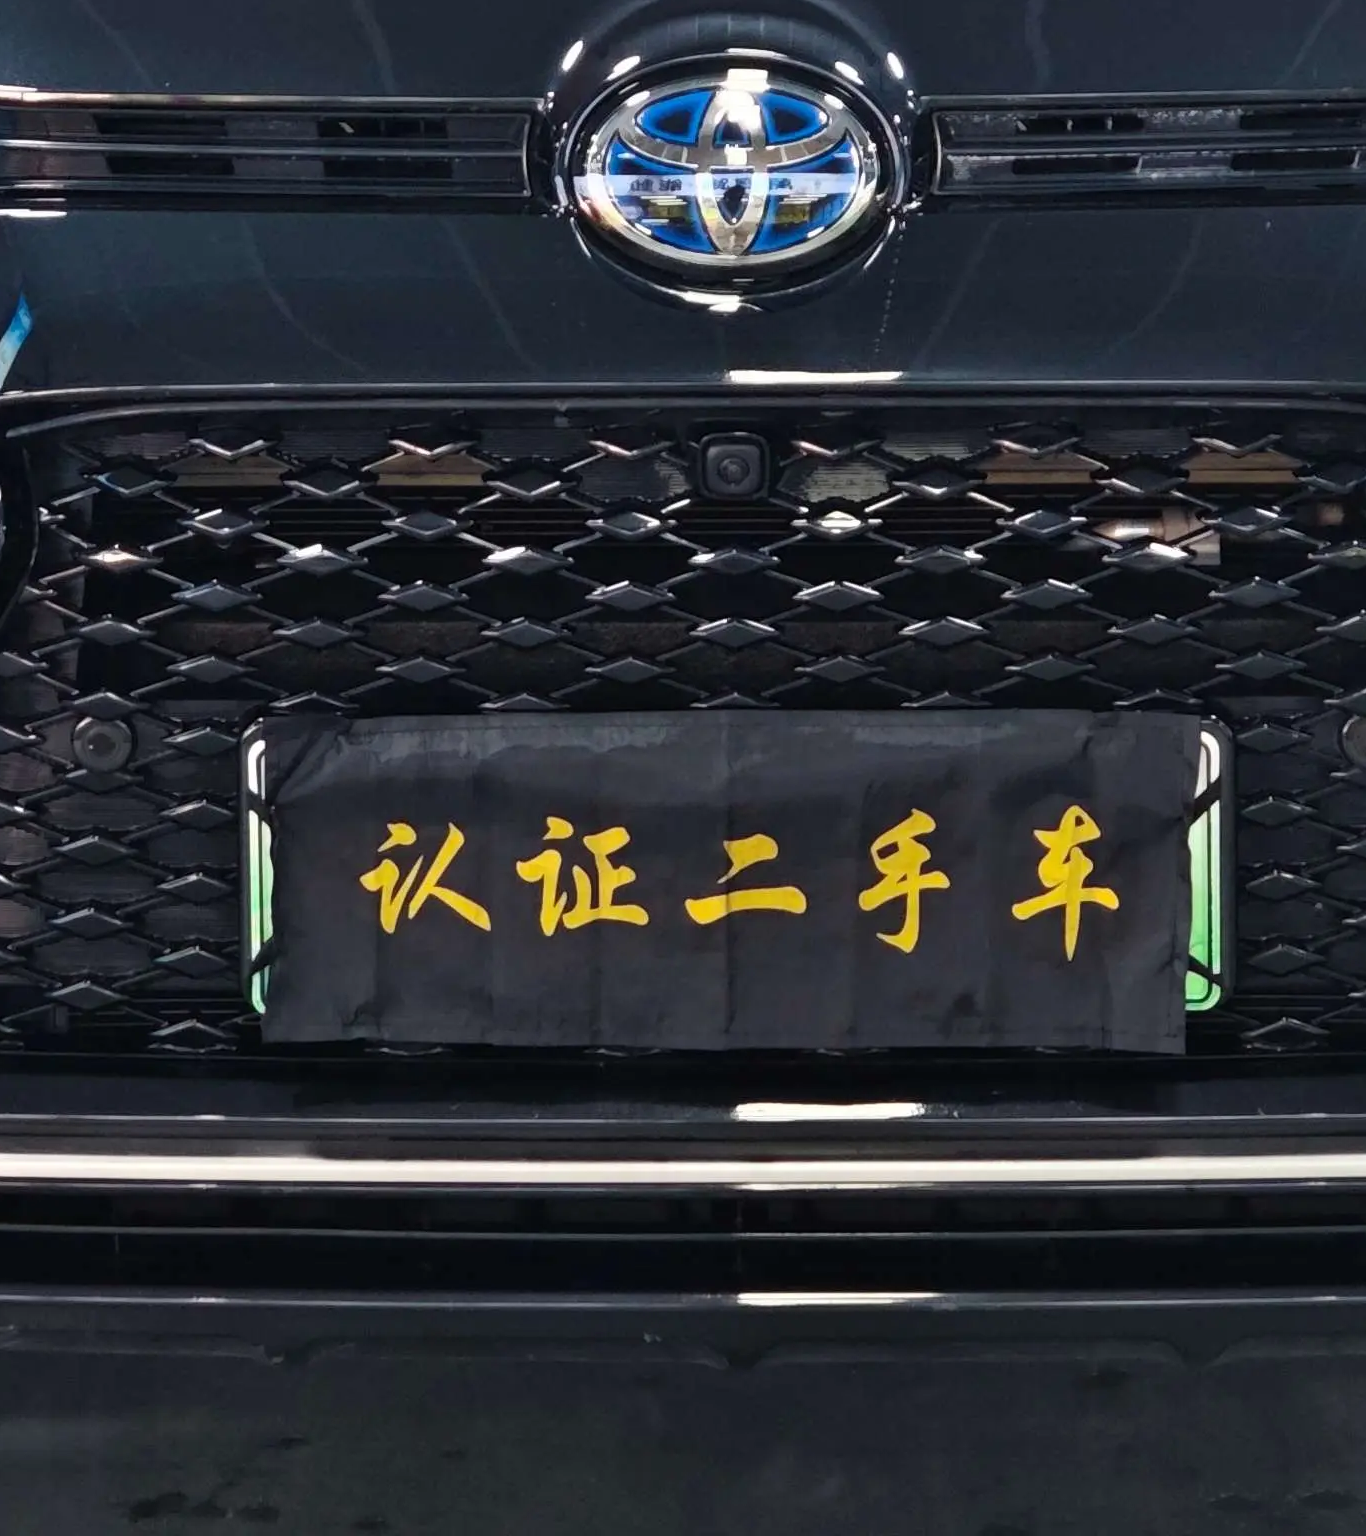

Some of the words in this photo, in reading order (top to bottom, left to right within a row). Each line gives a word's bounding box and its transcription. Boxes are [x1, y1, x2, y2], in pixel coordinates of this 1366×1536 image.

[358, 803, 1122, 963] 认证二手车
